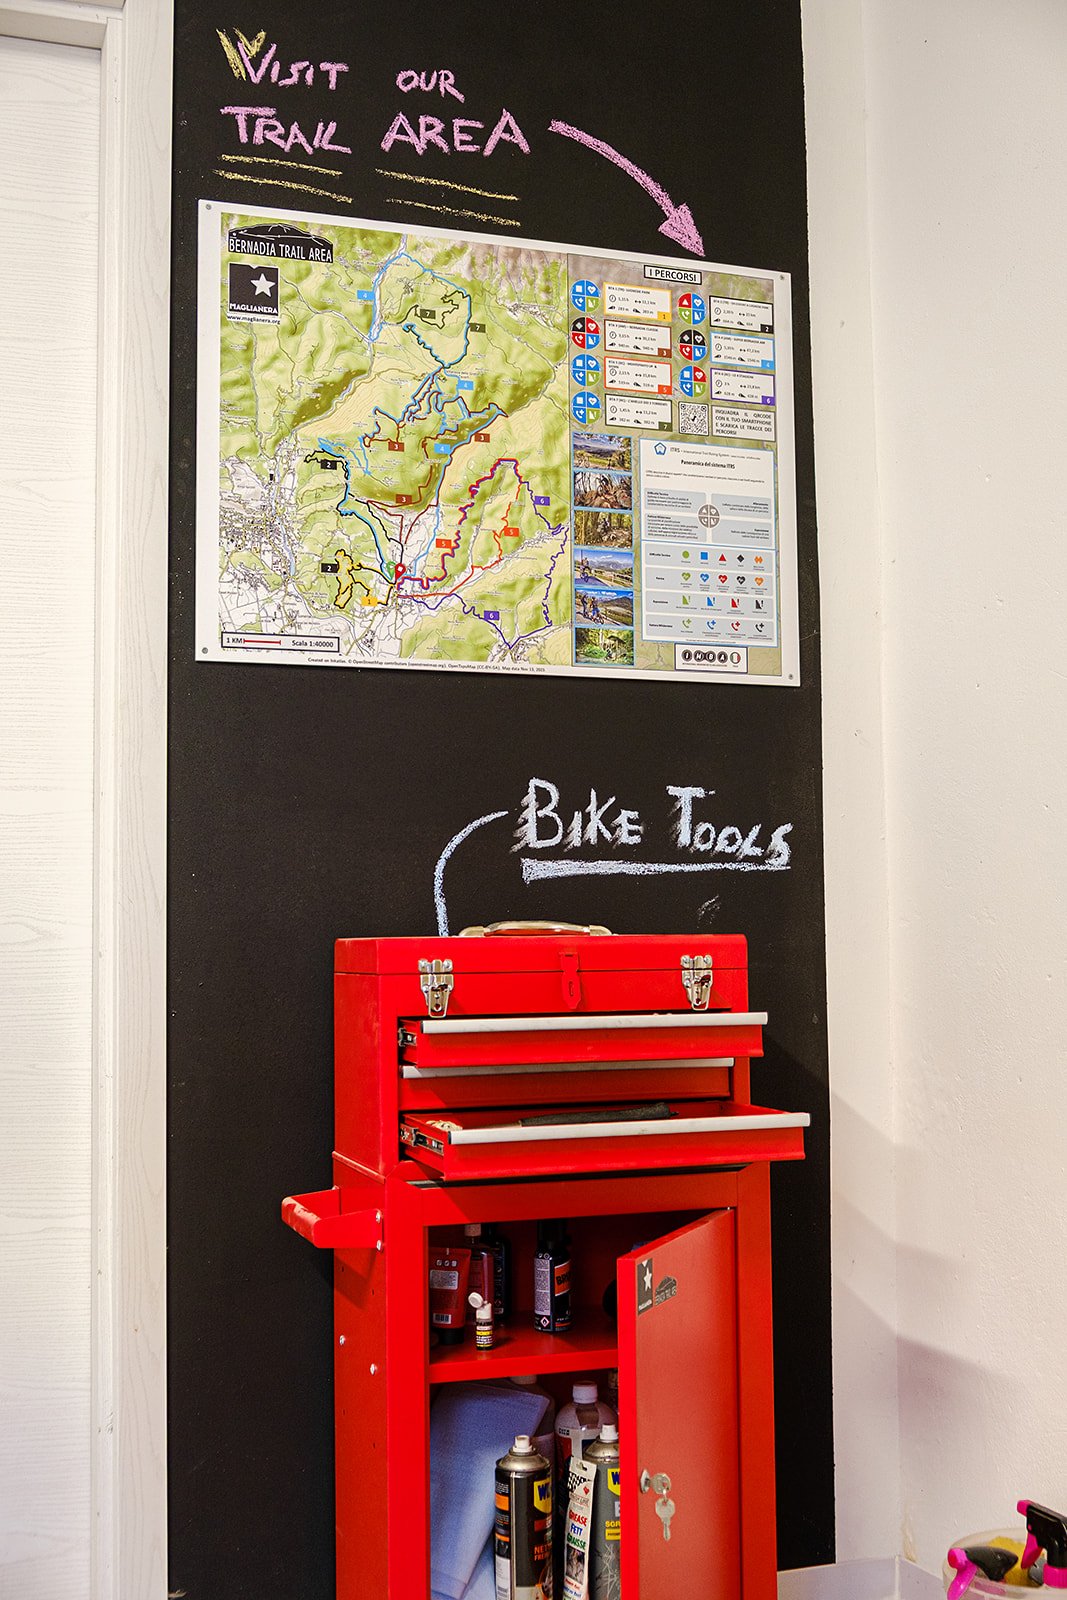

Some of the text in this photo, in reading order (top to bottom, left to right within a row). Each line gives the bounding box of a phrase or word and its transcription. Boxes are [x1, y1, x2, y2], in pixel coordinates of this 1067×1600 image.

[397, 69, 465, 103] OUR
[220, 105, 531, 156] TRAIL AREA
[229, 238, 332, 262] BERNADIA TRAIL AREA
[654, 270, 697, 282] PERCORSI
[229, 303, 278, 314] MAGLIANERA
[227, 315, 280, 324] www.maglianera.org
[666, 786, 794, 866] TOOLS
[569, 1510, 587, 1526] GREASE
[571, 1523, 582, 1536] FETT
[566, 1532, 586, 1550] GRAISSE
